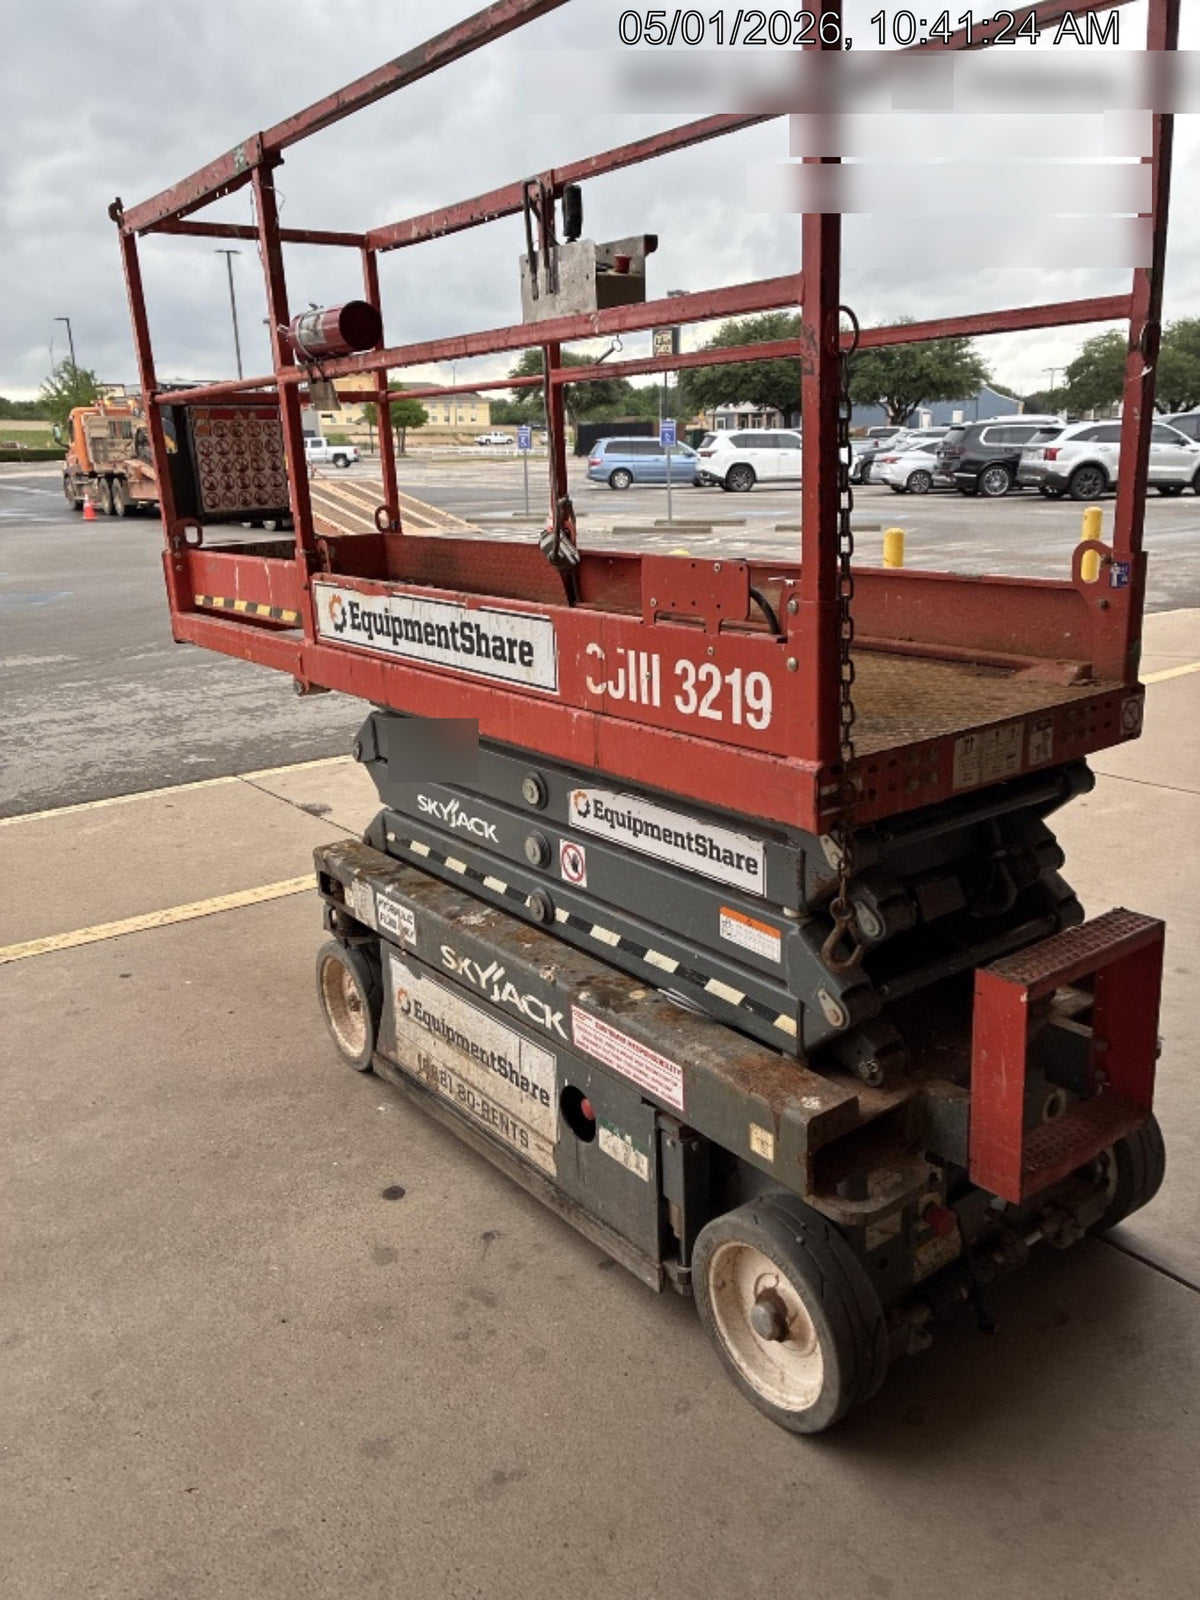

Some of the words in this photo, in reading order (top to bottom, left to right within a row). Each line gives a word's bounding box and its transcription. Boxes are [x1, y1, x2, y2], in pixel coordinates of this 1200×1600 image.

[347, 600, 535, 669] EquipmentShare
[674, 658, 773, 730] 3219
[416, 793, 500, 844] SKYJACK
[592, 798, 760, 877] EquipmentShare
[440, 944, 570, 1041] SKYJACK
[412, 998, 551, 1109] EquipmentShare
